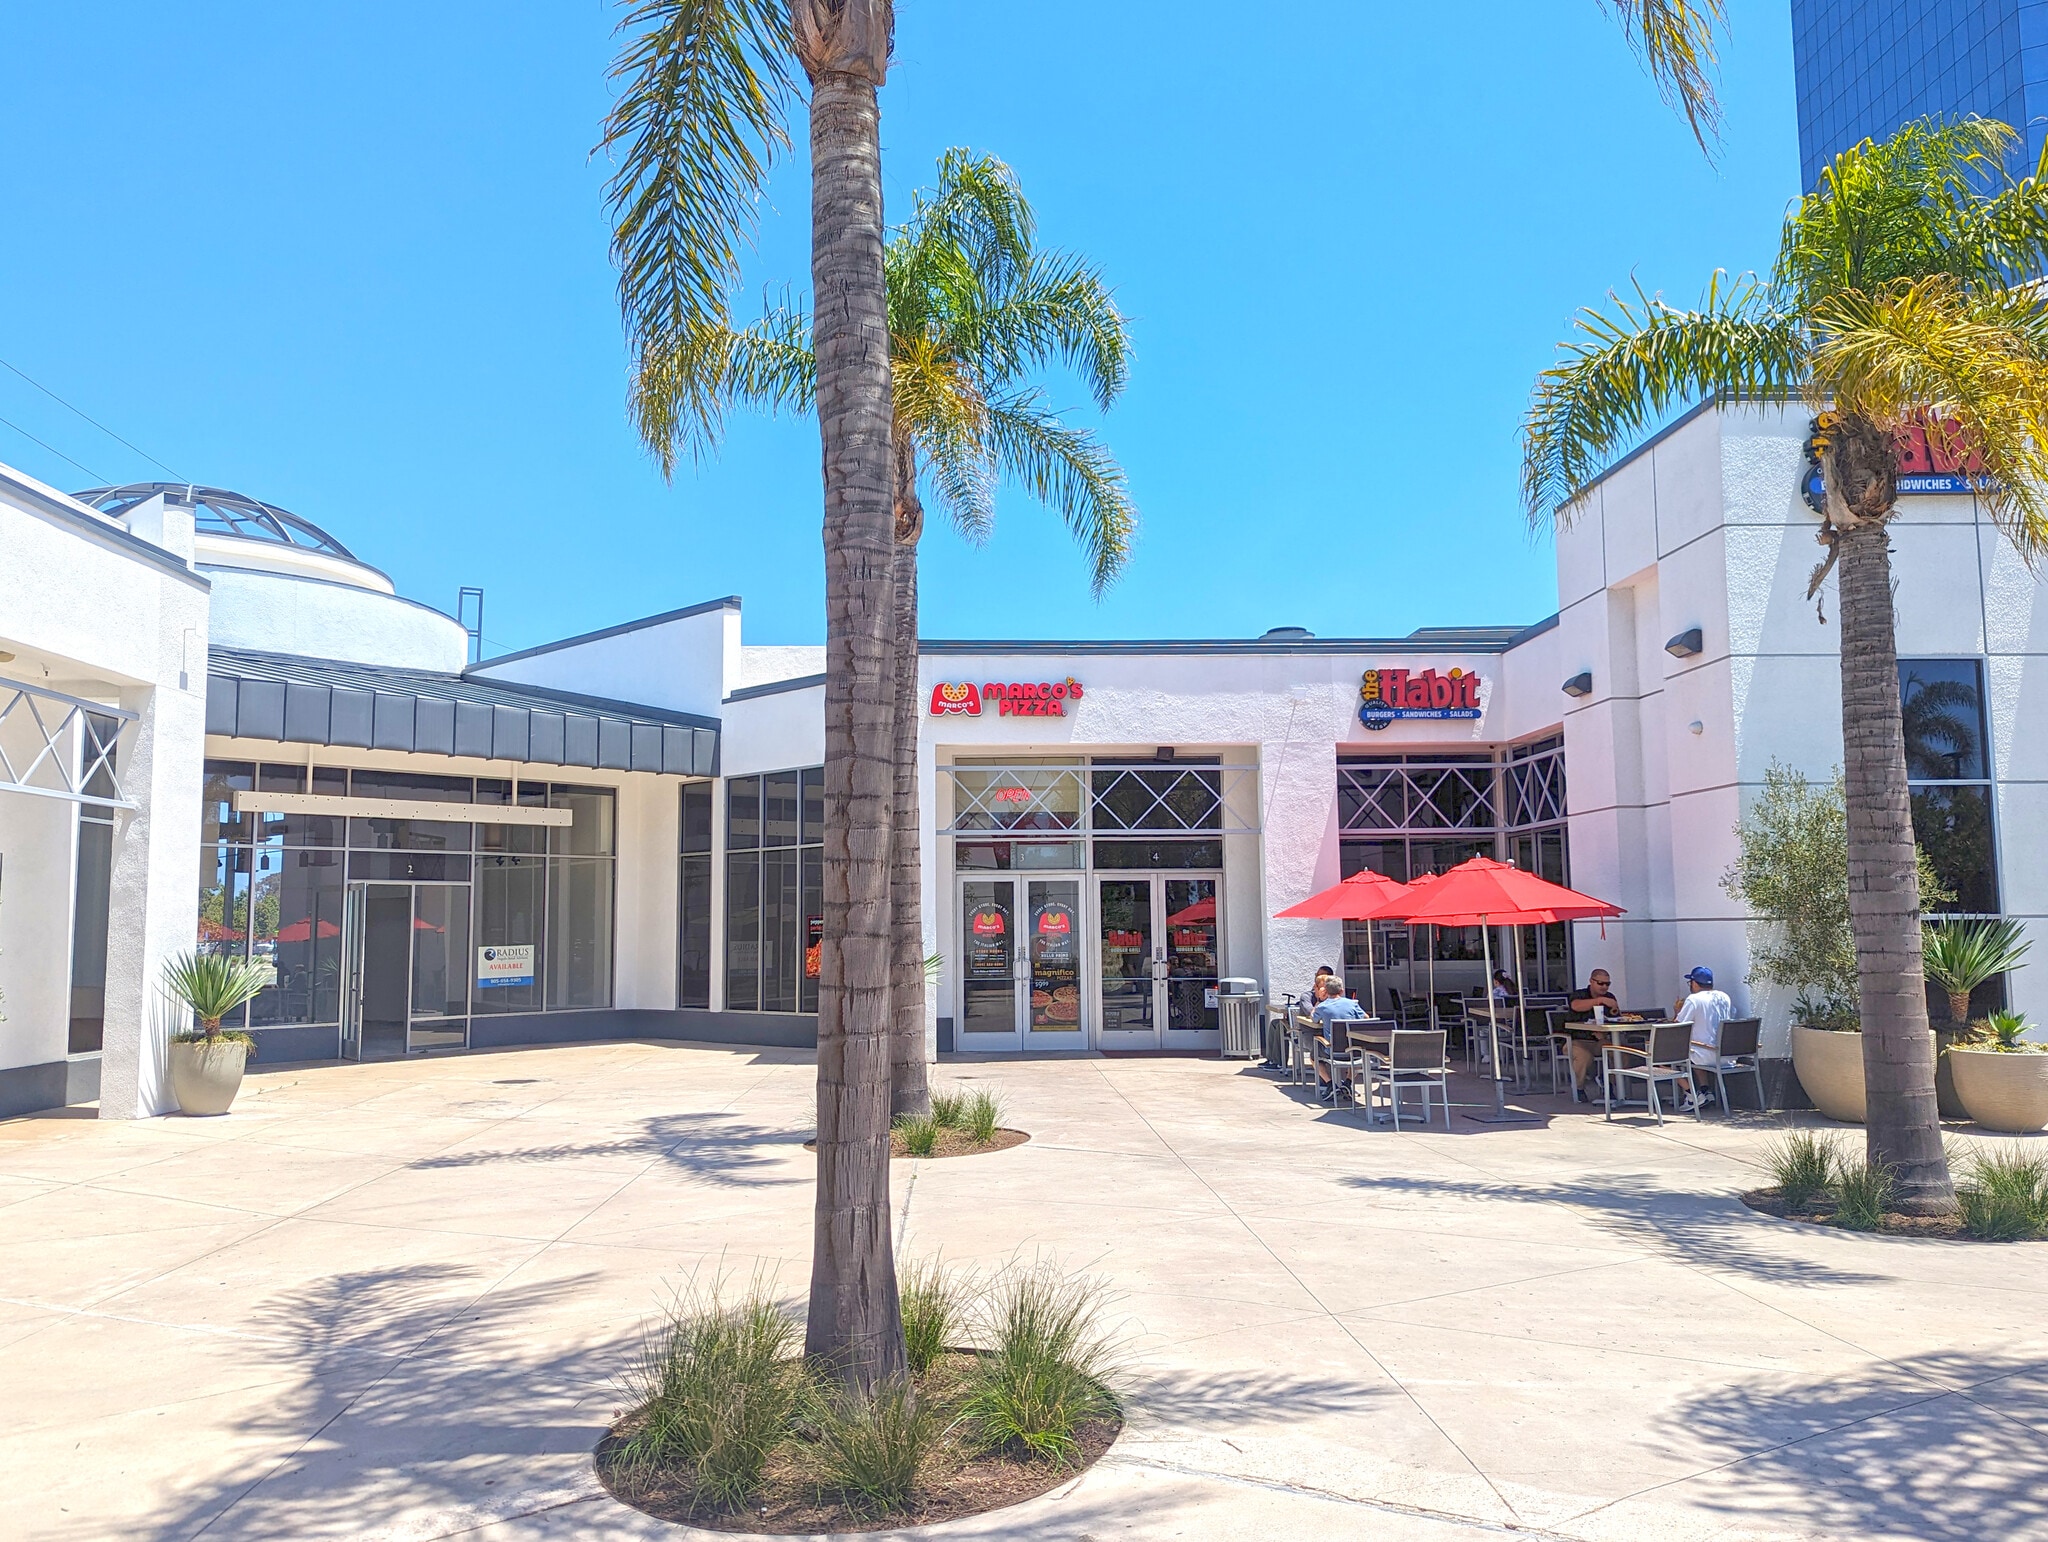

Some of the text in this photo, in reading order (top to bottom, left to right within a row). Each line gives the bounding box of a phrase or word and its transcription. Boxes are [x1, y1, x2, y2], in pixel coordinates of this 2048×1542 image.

[1897, 479, 1952, 490] NDWICHES
[982, 677, 1084, 700] MARCO'S
[1361, 670, 1379, 701] the
[1379, 668, 1481, 708] Habit
[938, 701, 974, 709] MARCO'S
[998, 700, 1063, 717] PIZZA
[1365, 700, 1388, 709] QUALITY
[1020, 853, 1025, 862] 3
[1152, 852, 1160, 861] 4
[407, 864, 414, 874] 2
[497, 948, 529, 957] RADIUS
[1034, 969, 1075, 977] magnifico
